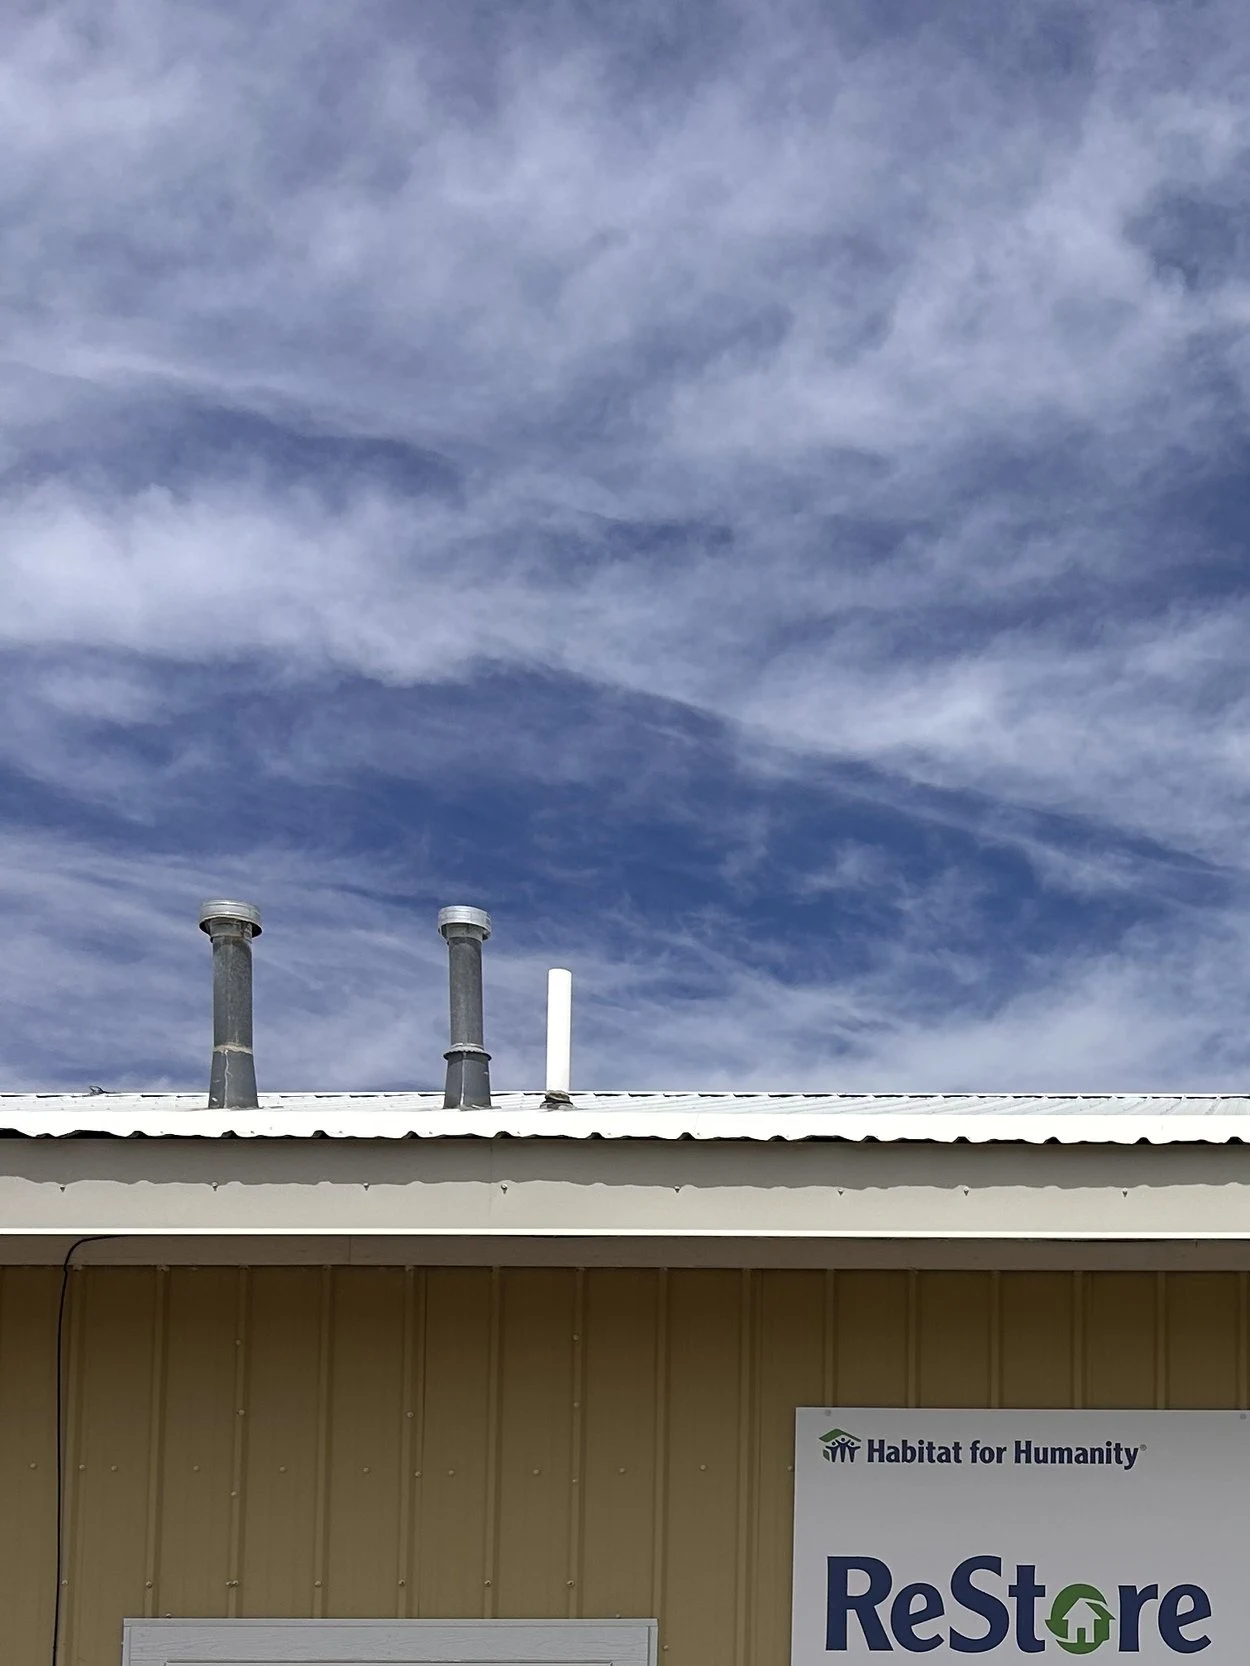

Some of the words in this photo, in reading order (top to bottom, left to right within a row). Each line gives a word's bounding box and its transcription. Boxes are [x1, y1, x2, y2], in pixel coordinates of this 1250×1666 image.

[867, 1438, 963, 1465] Habitat
[969, 1439, 1007, 1465] for
[1014, 1440, 1139, 1471] Humanity
